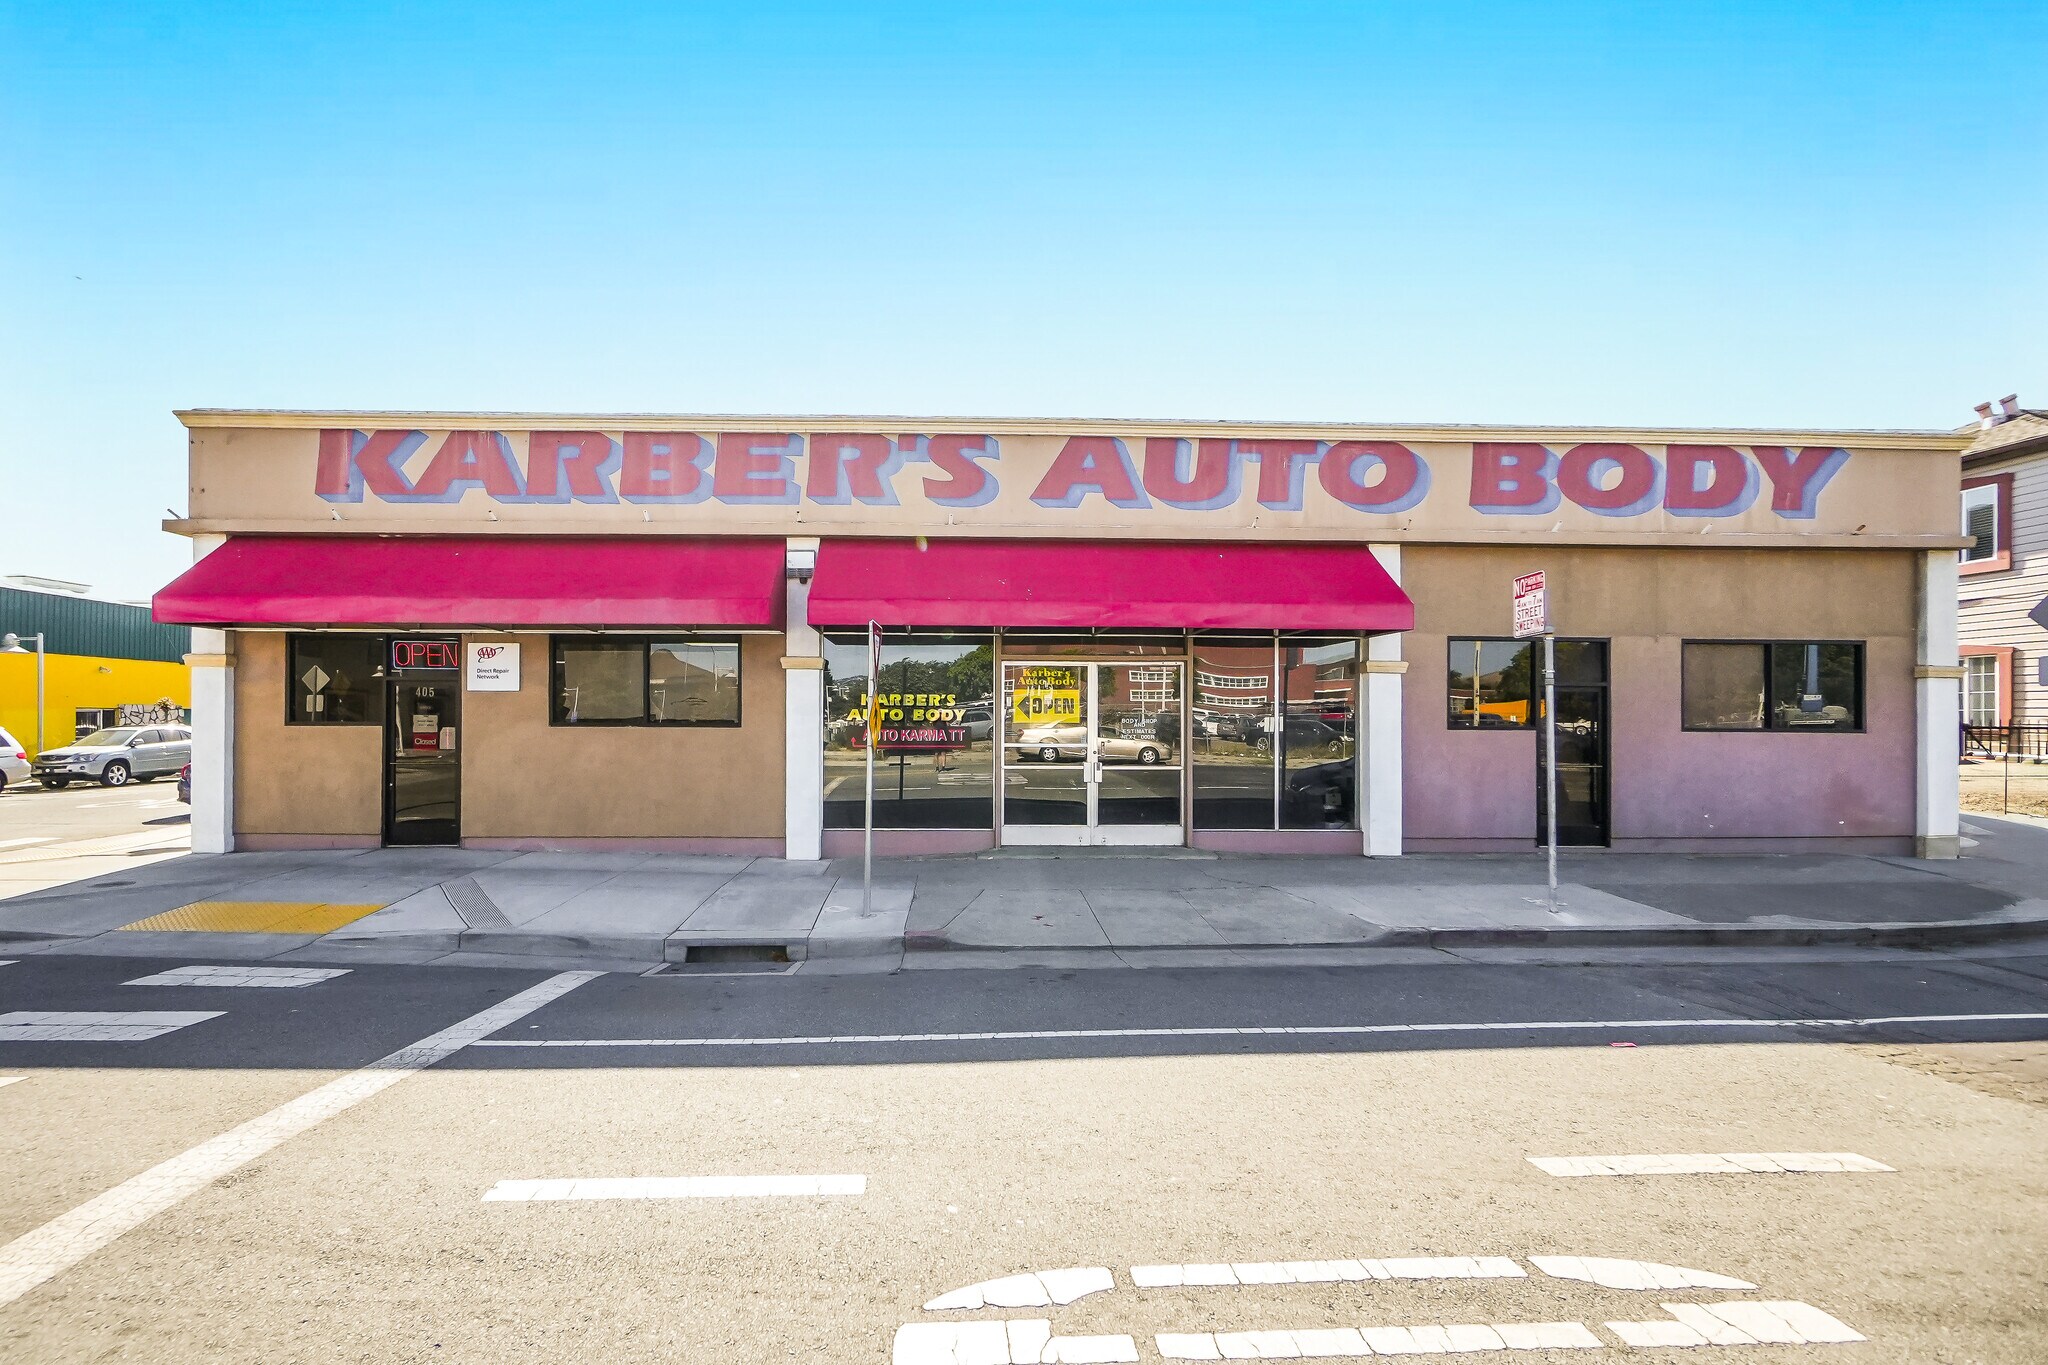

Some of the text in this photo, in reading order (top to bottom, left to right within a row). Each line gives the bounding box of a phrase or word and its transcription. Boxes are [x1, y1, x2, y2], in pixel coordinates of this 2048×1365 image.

[315, 428, 1850, 519] KARBER'S AUTO BODY
[1515, 579, 1526, 597] NO
[1517, 604, 1542, 620] STREET
[1515, 616, 1545, 632] SWEEPING
[395, 643, 458, 667] OPEN
[478, 647, 496, 659] AAA
[493, 667, 509, 675] Repair
[1022, 667, 1071, 678] Karber's
[415, 686, 435, 698] 405
[1032, 697, 1075, 714] OPEN
[913, 708, 967, 722] BODY
[862, 728, 899, 742] TO
[900, 728, 948, 742] KARMA
